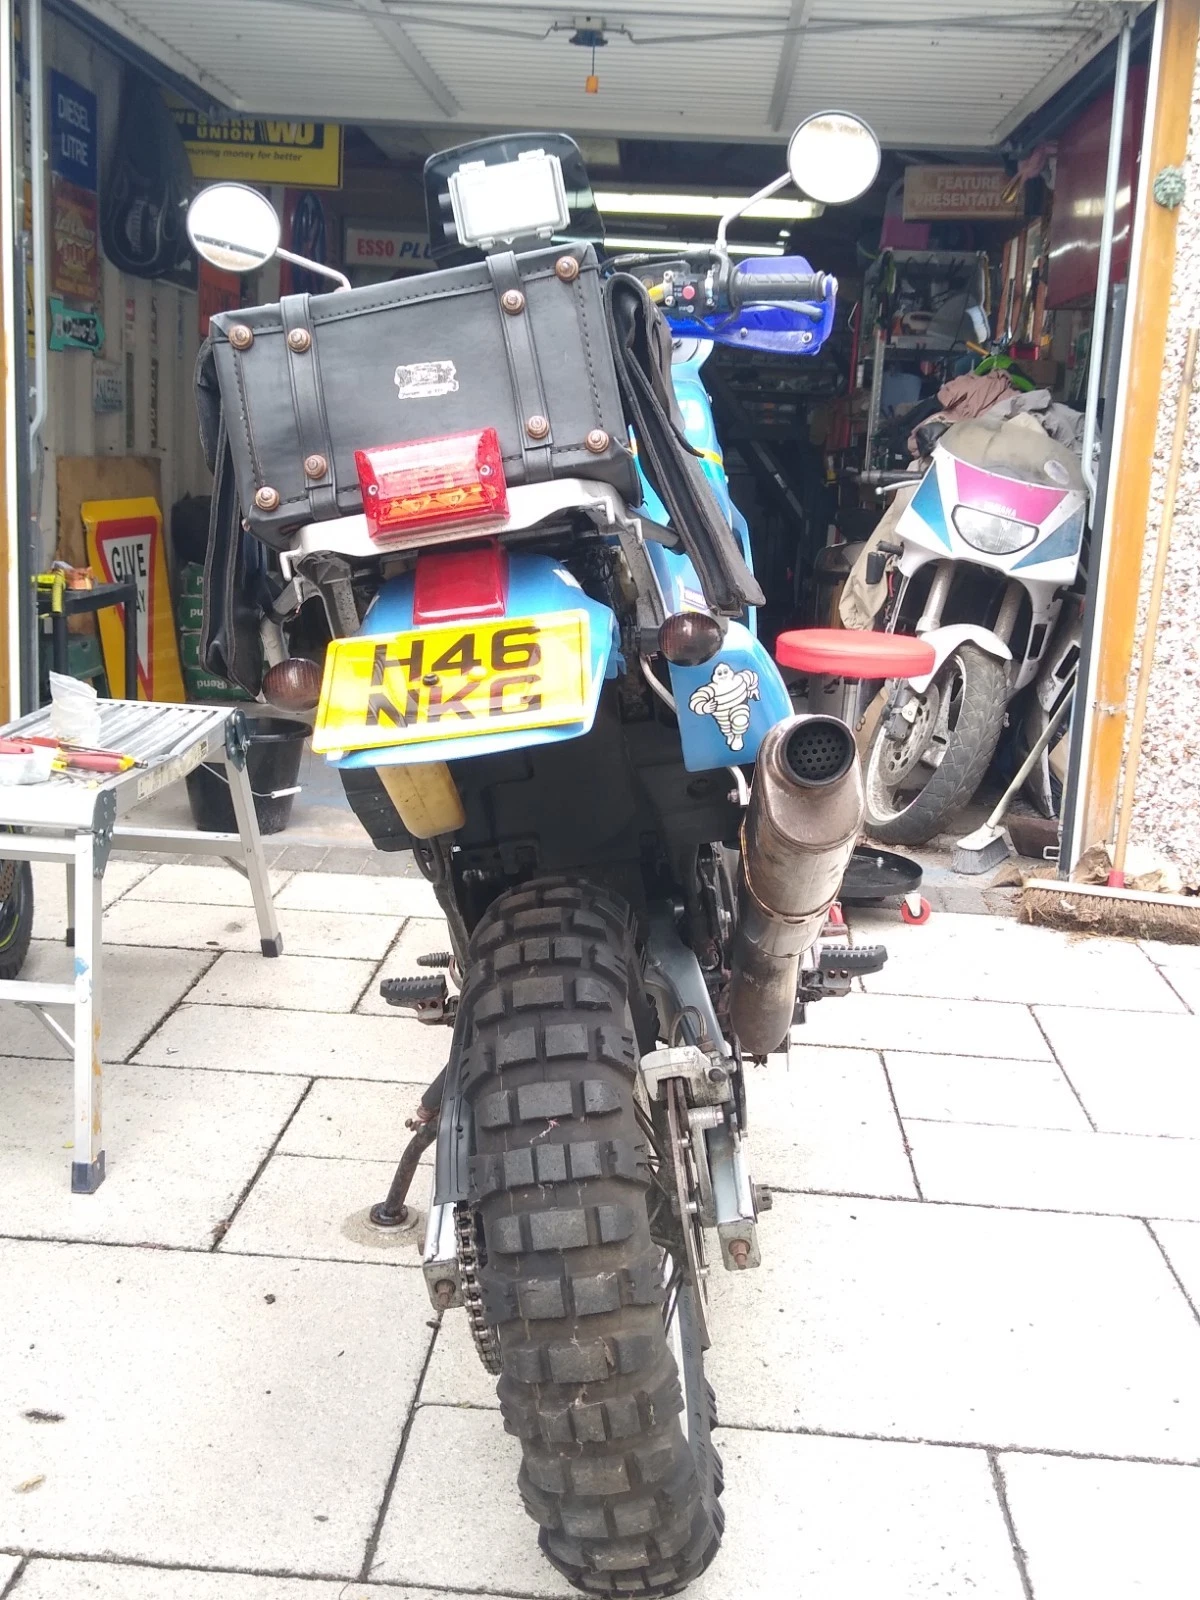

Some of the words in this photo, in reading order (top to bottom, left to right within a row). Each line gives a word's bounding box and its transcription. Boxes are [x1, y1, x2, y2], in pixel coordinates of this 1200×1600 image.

[58, 93, 90, 133] DIESEL
[197, 126, 255, 142] UNION
[62, 132, 88, 167] LITRE
[223, 150, 254, 161] money
[258, 150, 270, 160] for
[273, 151, 302, 162] better
[936, 176, 1000, 190] FEATURE
[914, 192, 1002, 207] PRESENTATI
[357, 238, 394, 257] ESSO
[112, 543, 147, 583] GIVE
[136, 589, 146, 613] AY
[371, 626, 541, 687] H46
[366, 674, 541, 728] NKG
